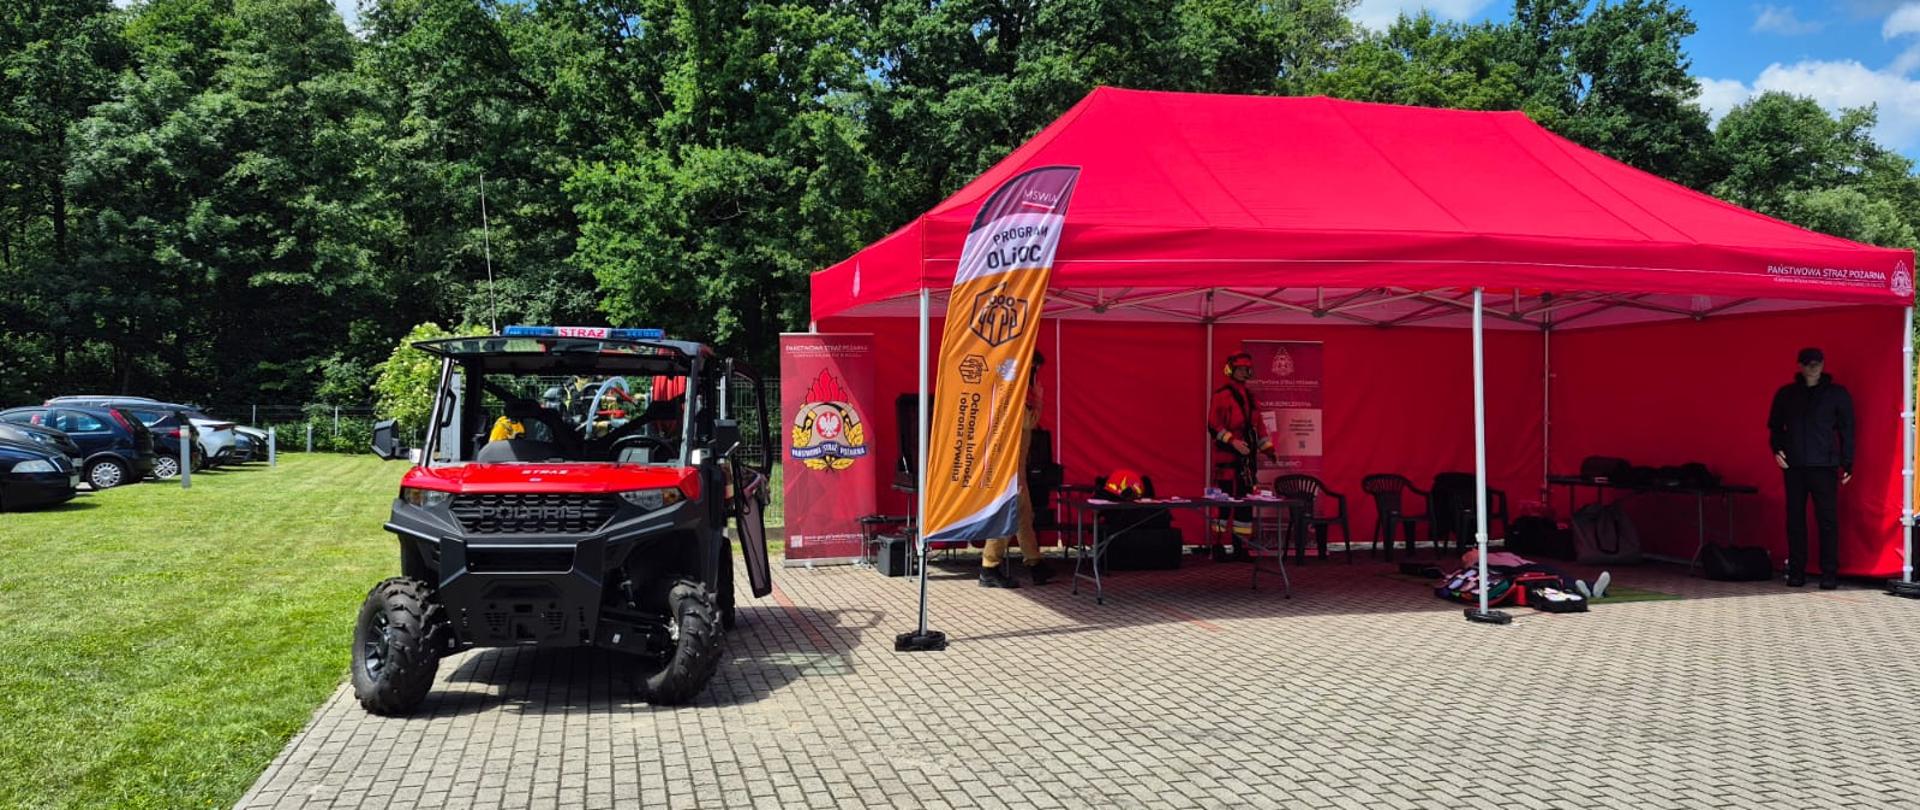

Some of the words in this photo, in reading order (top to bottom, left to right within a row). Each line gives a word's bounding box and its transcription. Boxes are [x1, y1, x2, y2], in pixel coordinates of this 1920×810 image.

[992, 225, 1049, 246] PROGRAM
[1767, 264, 1821, 276] PAŃSTWOWA
[1823, 268, 1848, 278] STRAŻ
[1849, 269, 1886, 280] POŻARNA
[957, 398, 969, 437] obrona
[967, 393, 981, 439] Ochrona
[951, 439, 963, 482] cywilna
[961, 442, 976, 488] ludności
[479, 505, 582, 519] POLARIS
